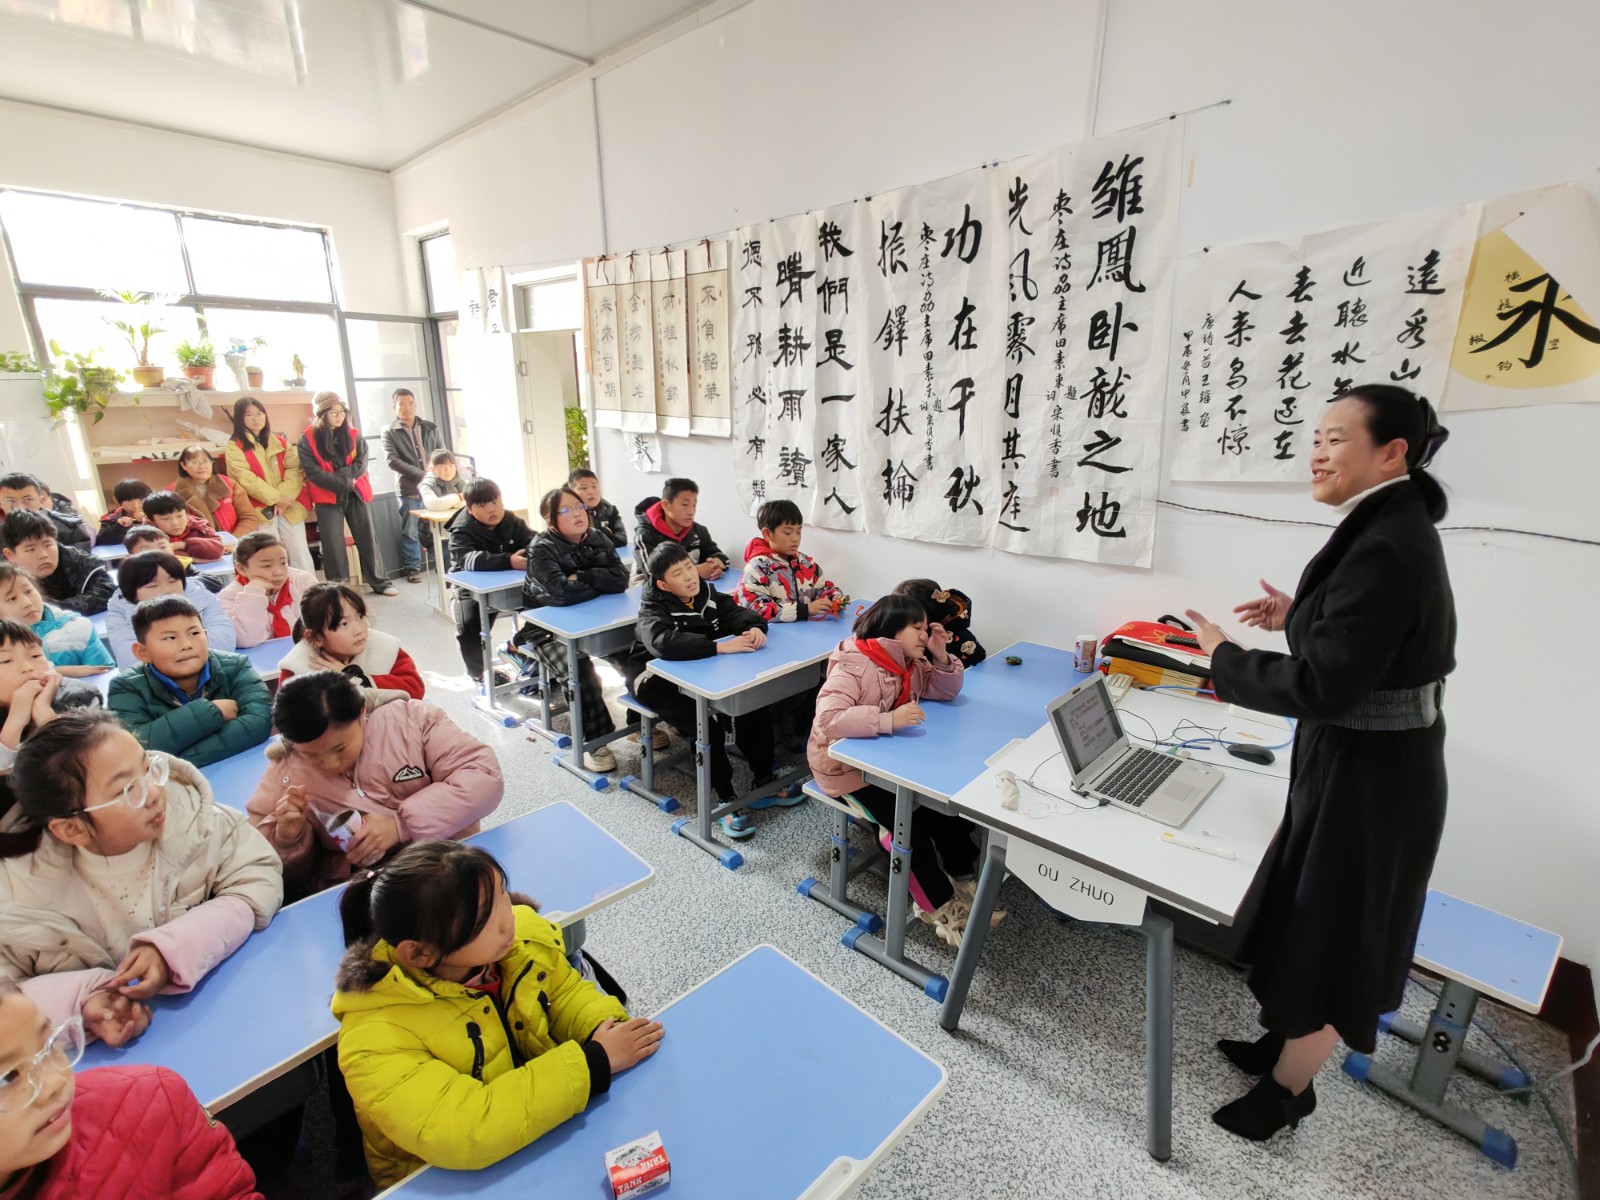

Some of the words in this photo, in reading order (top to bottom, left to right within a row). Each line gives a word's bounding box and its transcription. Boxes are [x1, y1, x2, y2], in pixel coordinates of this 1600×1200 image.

[772, 251, 816, 489] 晴耕雨讀
[816, 220, 857, 516] 我們是一家人
[940, 203, 984, 516] 功在千秋
[1037, 863, 1059, 882] OU
[1069, 876, 1115, 906] ZHUO
[617, 1176, 643, 1194] TANK
